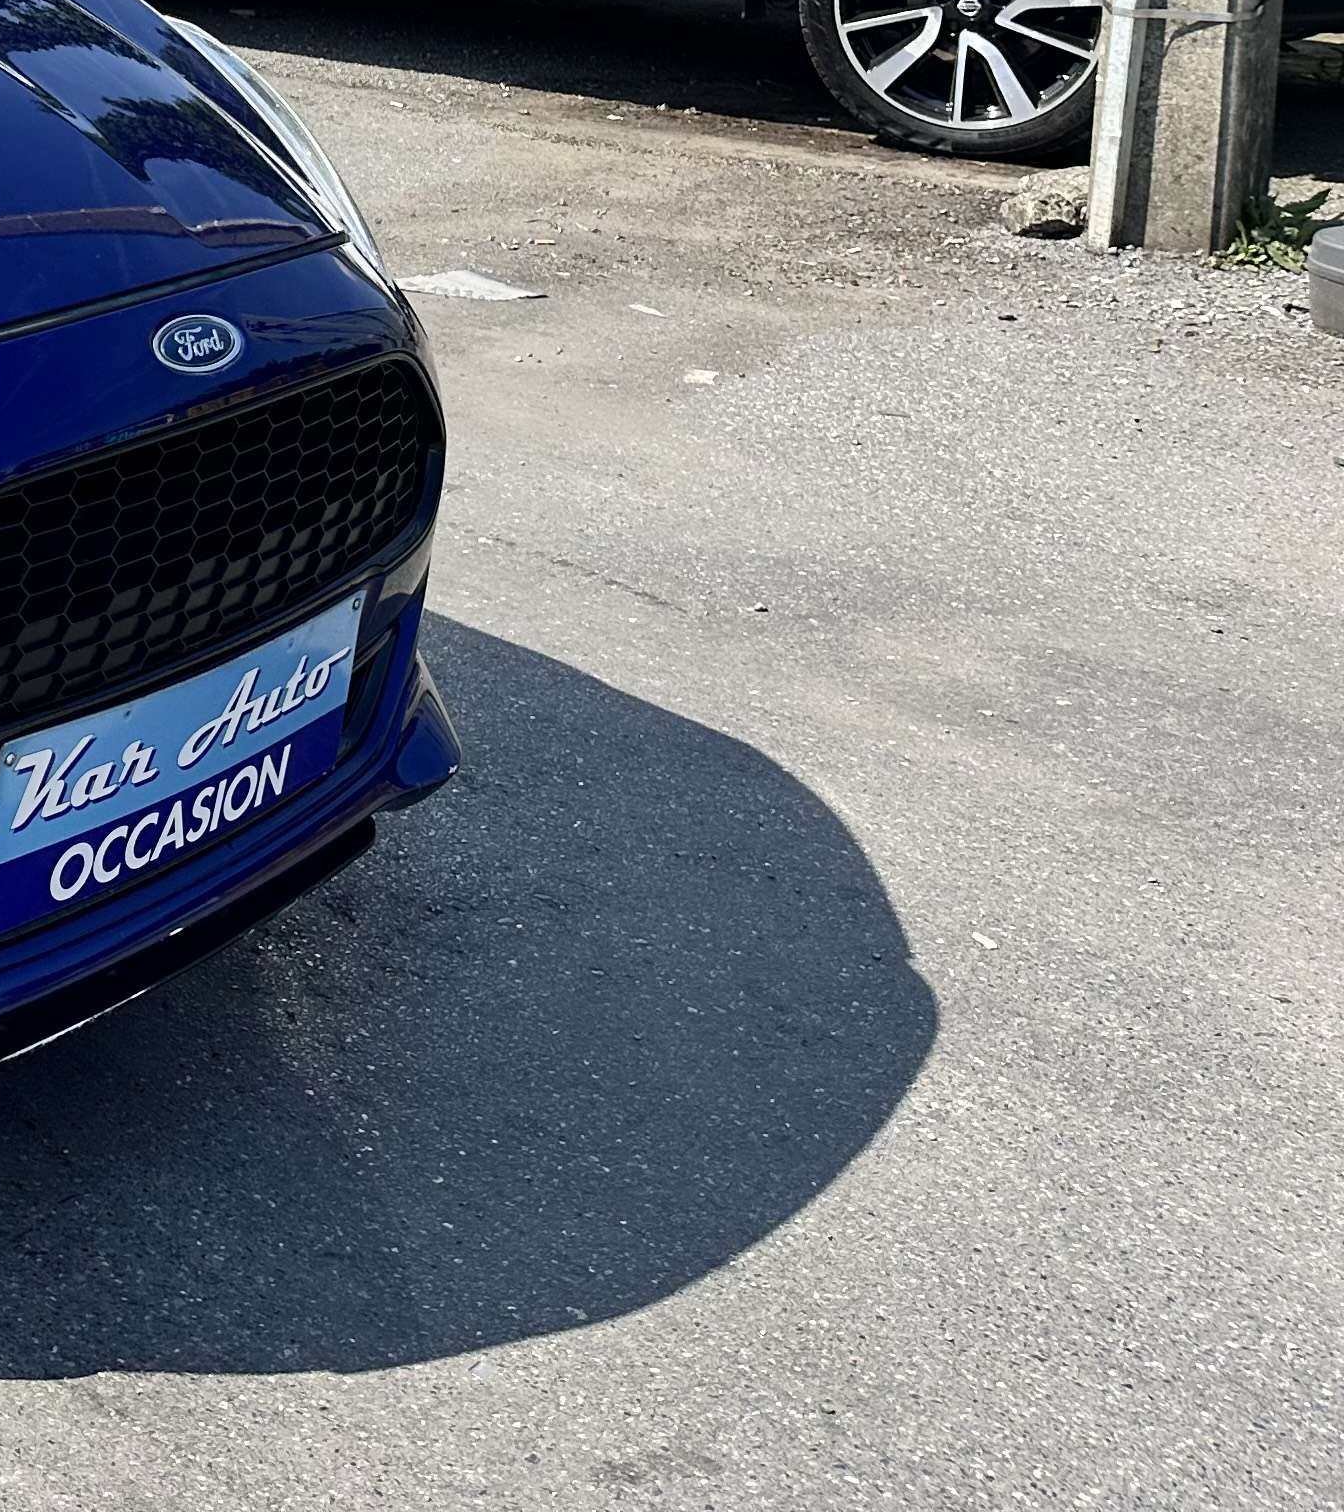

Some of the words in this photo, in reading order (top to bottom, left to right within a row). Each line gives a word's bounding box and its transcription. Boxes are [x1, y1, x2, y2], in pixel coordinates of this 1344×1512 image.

[173, 326, 225, 362] Ford
[11, 733, 159, 833] Kar
[176, 646, 351, 769] Auto
[49, 742, 293, 902] OCCASION
